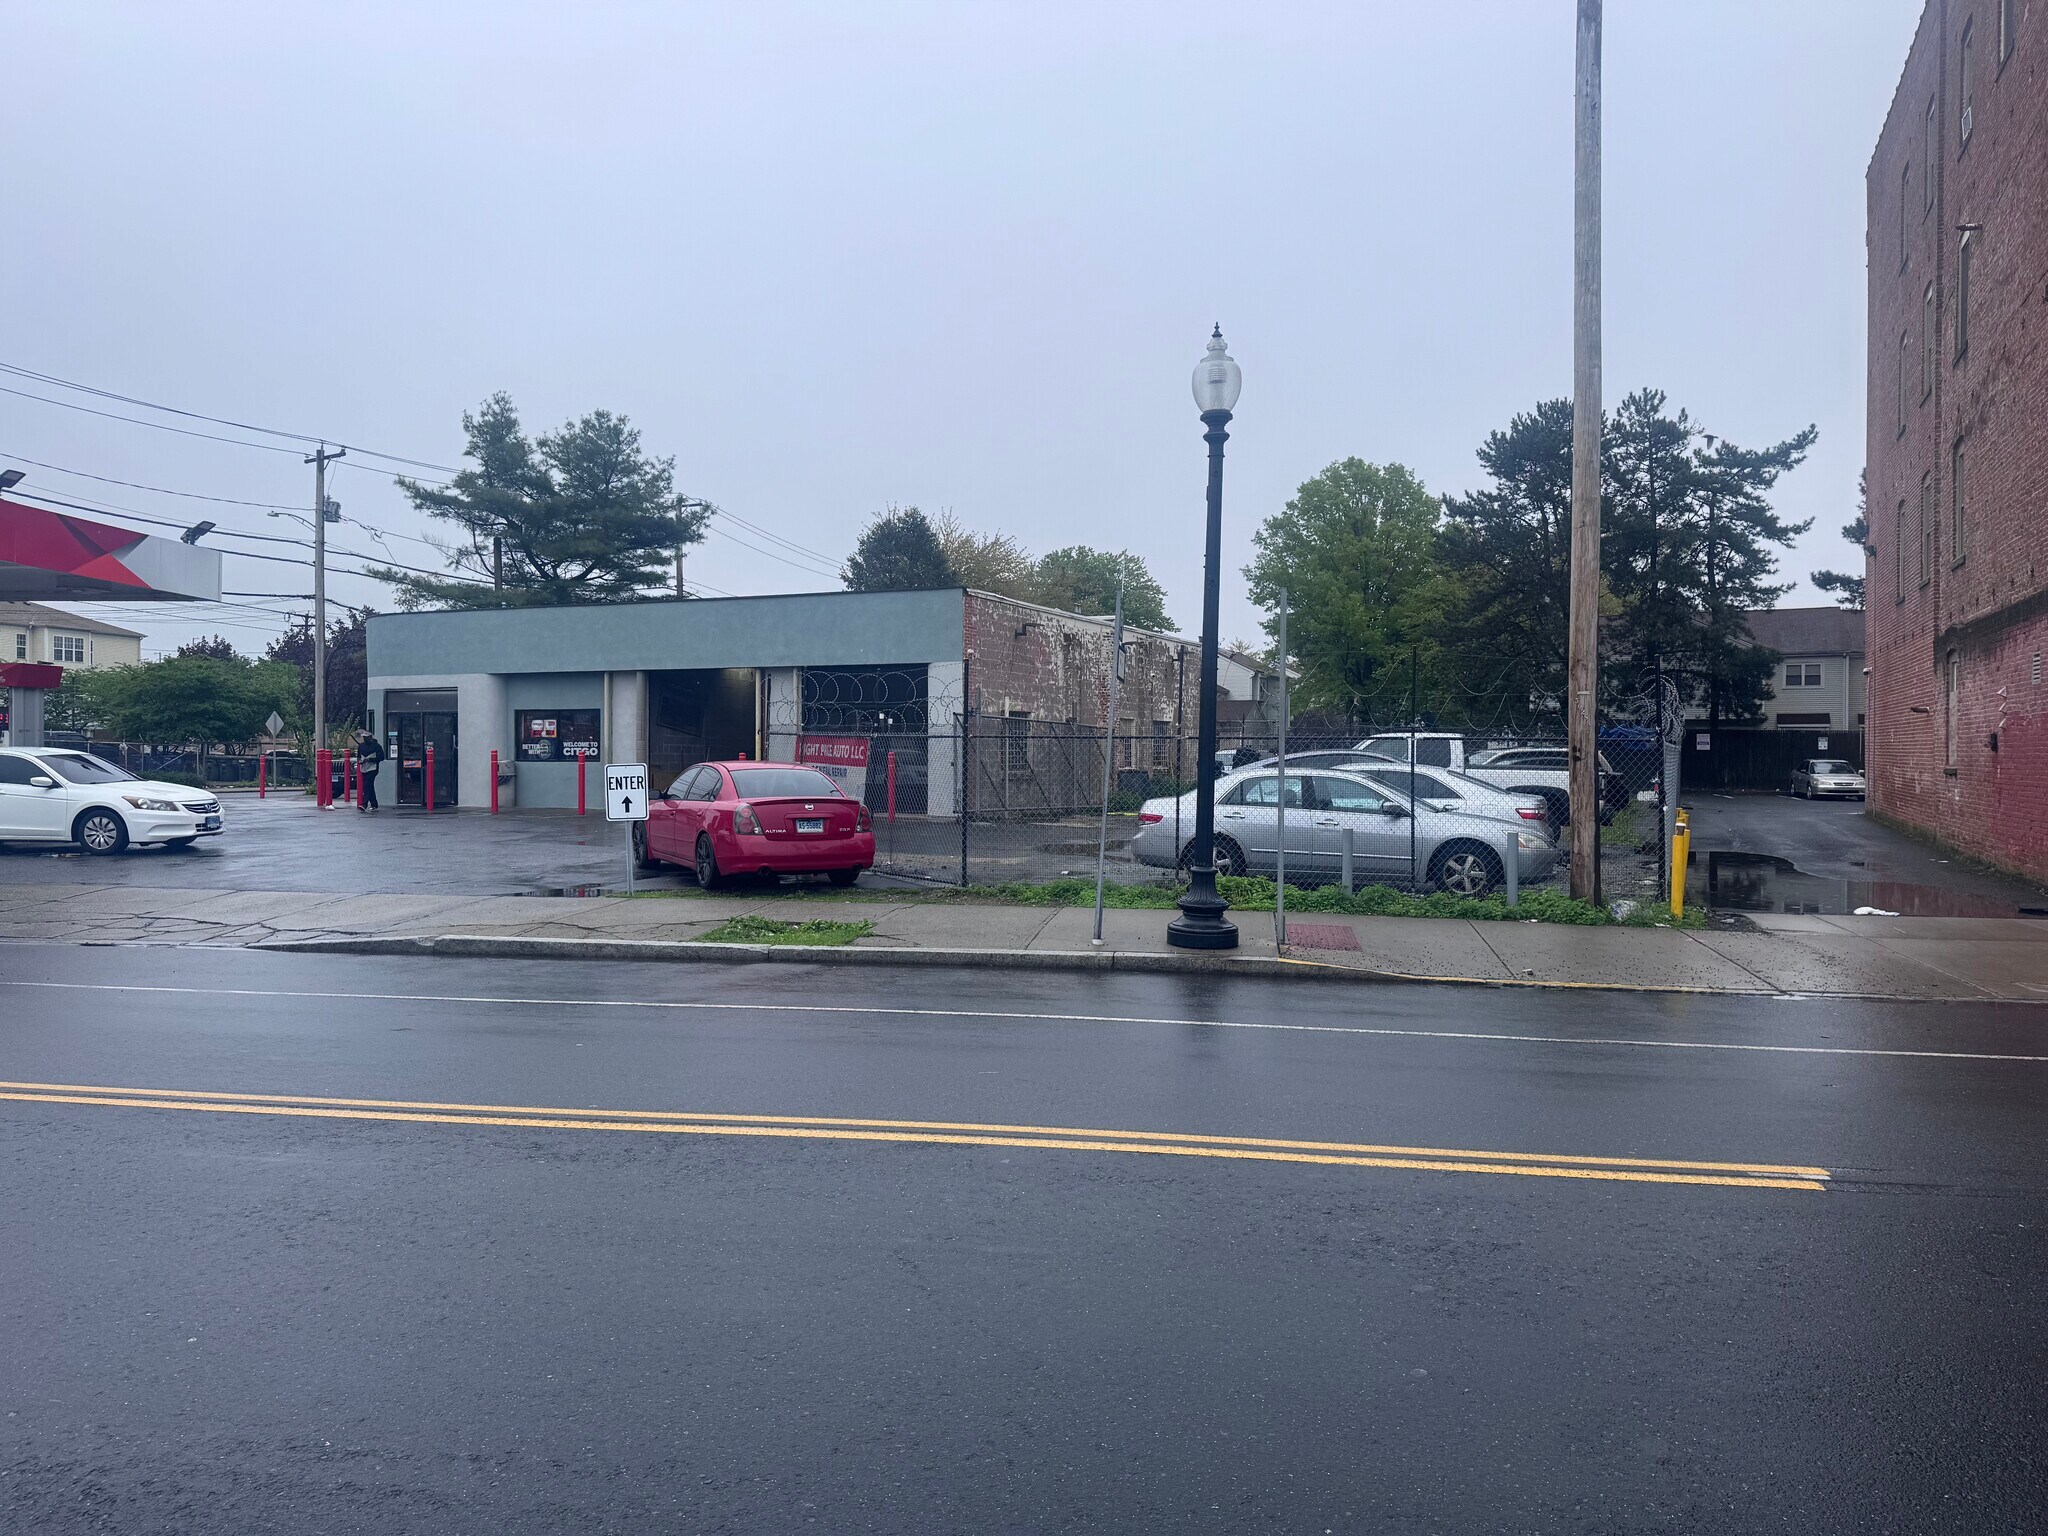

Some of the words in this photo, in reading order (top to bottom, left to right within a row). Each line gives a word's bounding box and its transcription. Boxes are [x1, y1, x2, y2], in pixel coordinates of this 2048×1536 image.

[563, 748, 598, 756] CITGO
[833, 745, 850, 758] AUTO
[850, 746, 865, 759] LLC
[608, 776, 644, 790] ENTER
